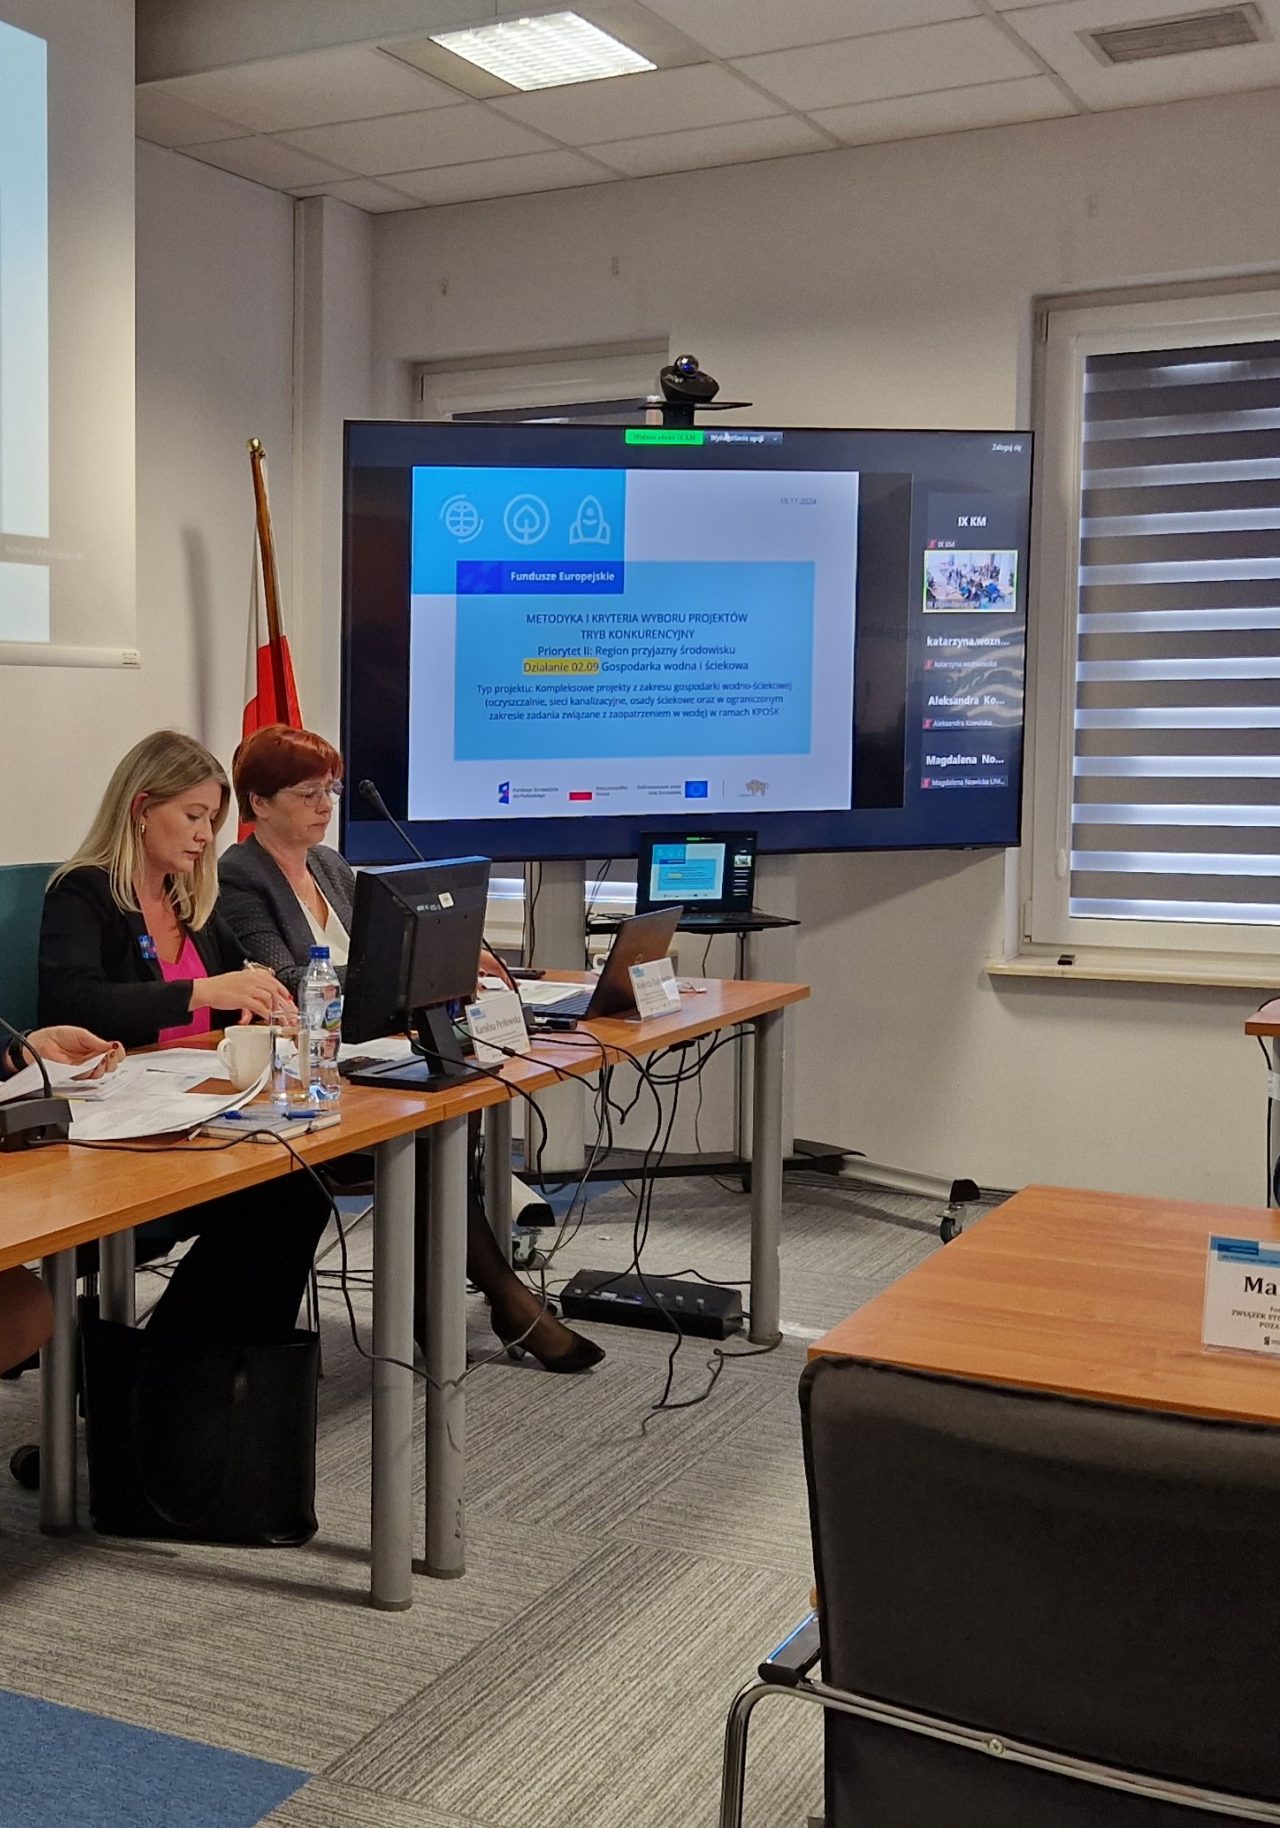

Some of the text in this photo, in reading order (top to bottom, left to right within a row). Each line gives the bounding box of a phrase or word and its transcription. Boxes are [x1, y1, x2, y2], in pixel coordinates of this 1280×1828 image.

[958, 516, 987, 526] IX KM
[510, 571, 615, 583] Fundusze Europejskie
[526, 613, 583, 624] METODYKA
[592, 613, 640, 623] KRYTERIA
[641, 613, 686, 623] WYBORU
[688, 611, 748, 625] PROJEKTÓW
[580, 629, 695, 641] TRYB KONKURENCYJNY
[537, 646, 582, 657] Priorytet
[595, 646, 629, 657] Region
[631, 646, 678, 657] przyjazny
[679, 645, 736, 655] środowisku
[523, 662, 570, 672] Działanie
[571, 662, 599, 672] 02.09
[601, 661, 661, 673] Gospodarka
[663, 661, 697, 671] wodna
[705, 660, 748, 671] ściekowa
[477, 685, 491, 695] Typ
[495, 684, 532, 695] projektu:
[535, 684, 594, 695] Kompleksowe
[596, 684, 631, 695] projekty
[640, 682, 672, 691] zakresu
[673, 681, 719, 693] gospodarki
[722, 681, 792, 692] wodno-ściekowej
[549, 697, 568, 706] sieci
[630, 695, 655, 706] osady
[657, 695, 694, 705] ściekowe
[726, 695, 784, 705] ograniczonym
[928, 696, 979, 706] Aleksandra
[489, 711, 524, 720] zakresie
[527, 711, 560, 720] zadania
[562, 710, 600, 720] związane
[609, 709, 670, 720] zaopatrzeniem
[710, 709, 717, 717] w
[719, 708, 749, 717] ramach
[926, 755, 977, 767] Magdalena
[1244, 1276, 1280, 1296] Ma
[1232, 1309, 1265, 1319] ZWIĄZEK
